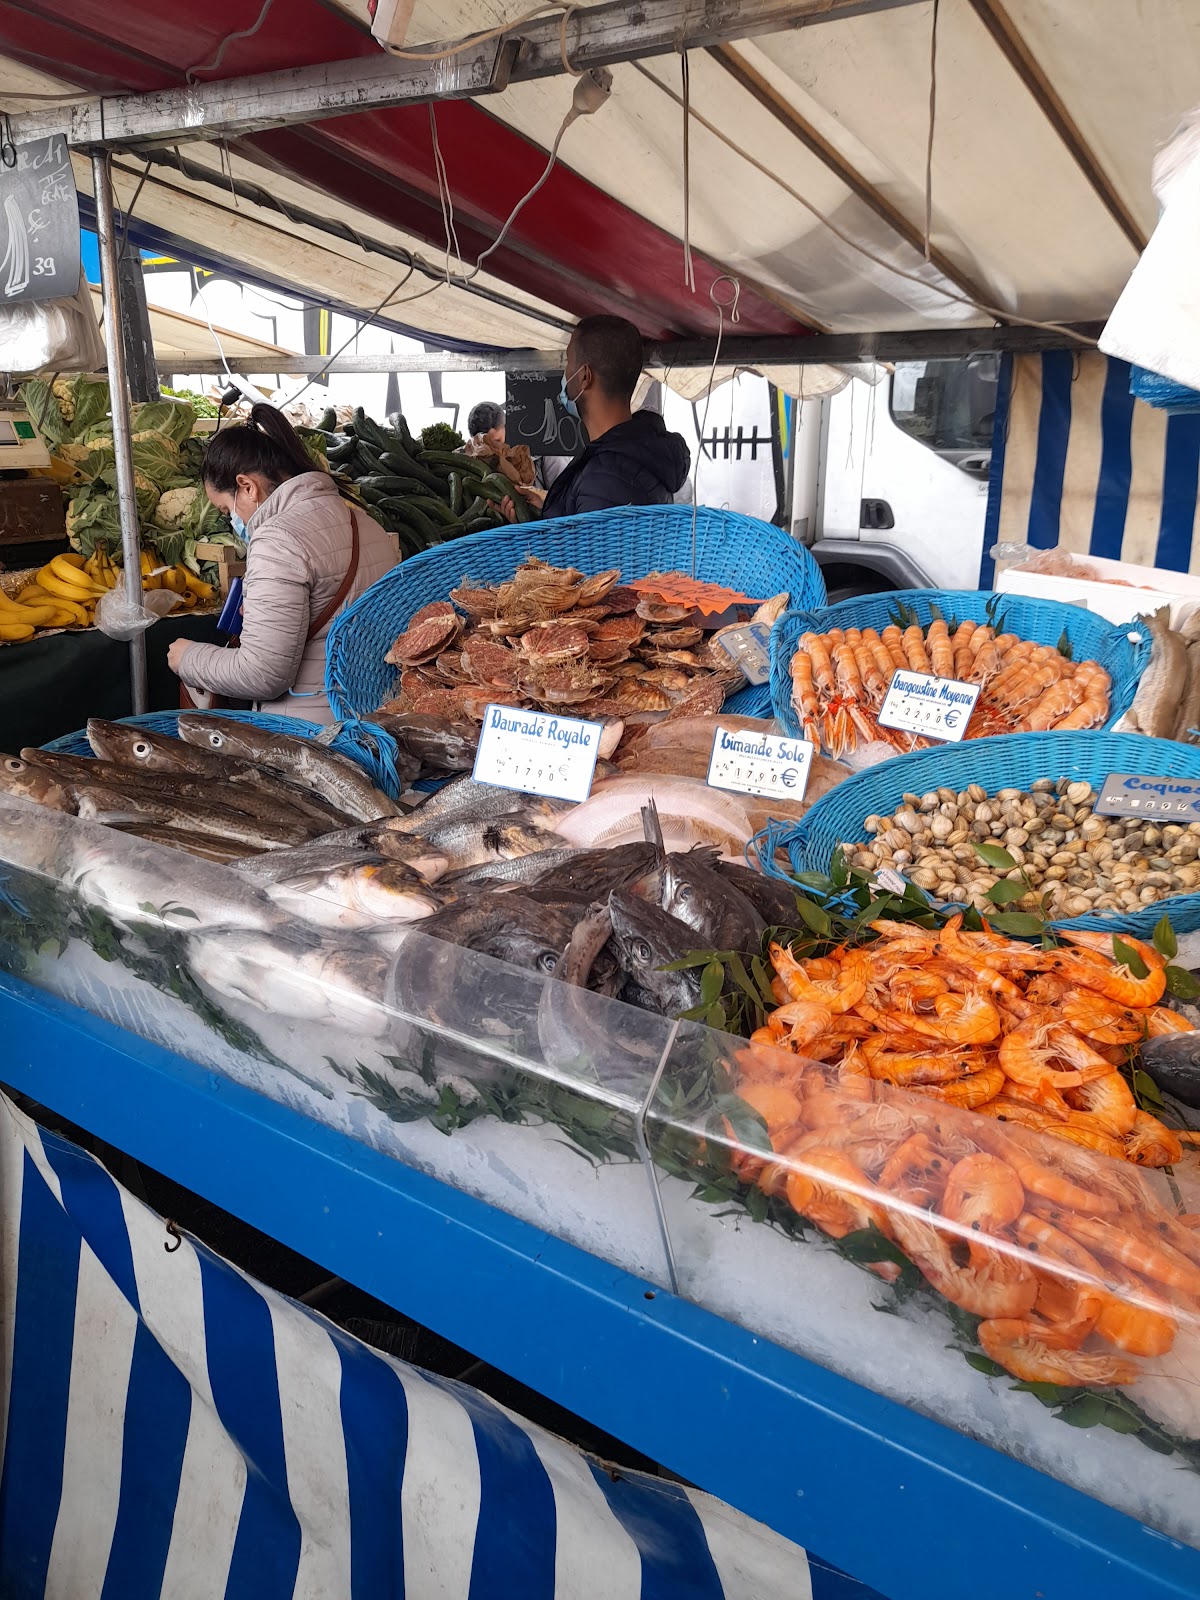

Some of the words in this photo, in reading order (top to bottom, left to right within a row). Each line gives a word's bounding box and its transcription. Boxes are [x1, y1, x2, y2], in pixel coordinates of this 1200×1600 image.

[32, 257, 57, 276] 39
[893, 673, 938, 698] Langoustine
[938, 683, 974, 707] Moyenne
[490, 709, 544, 738] Daurade
[547, 720, 591, 749] Royale
[720, 732, 773, 758] Limande
[777, 742, 805, 763] Sole
